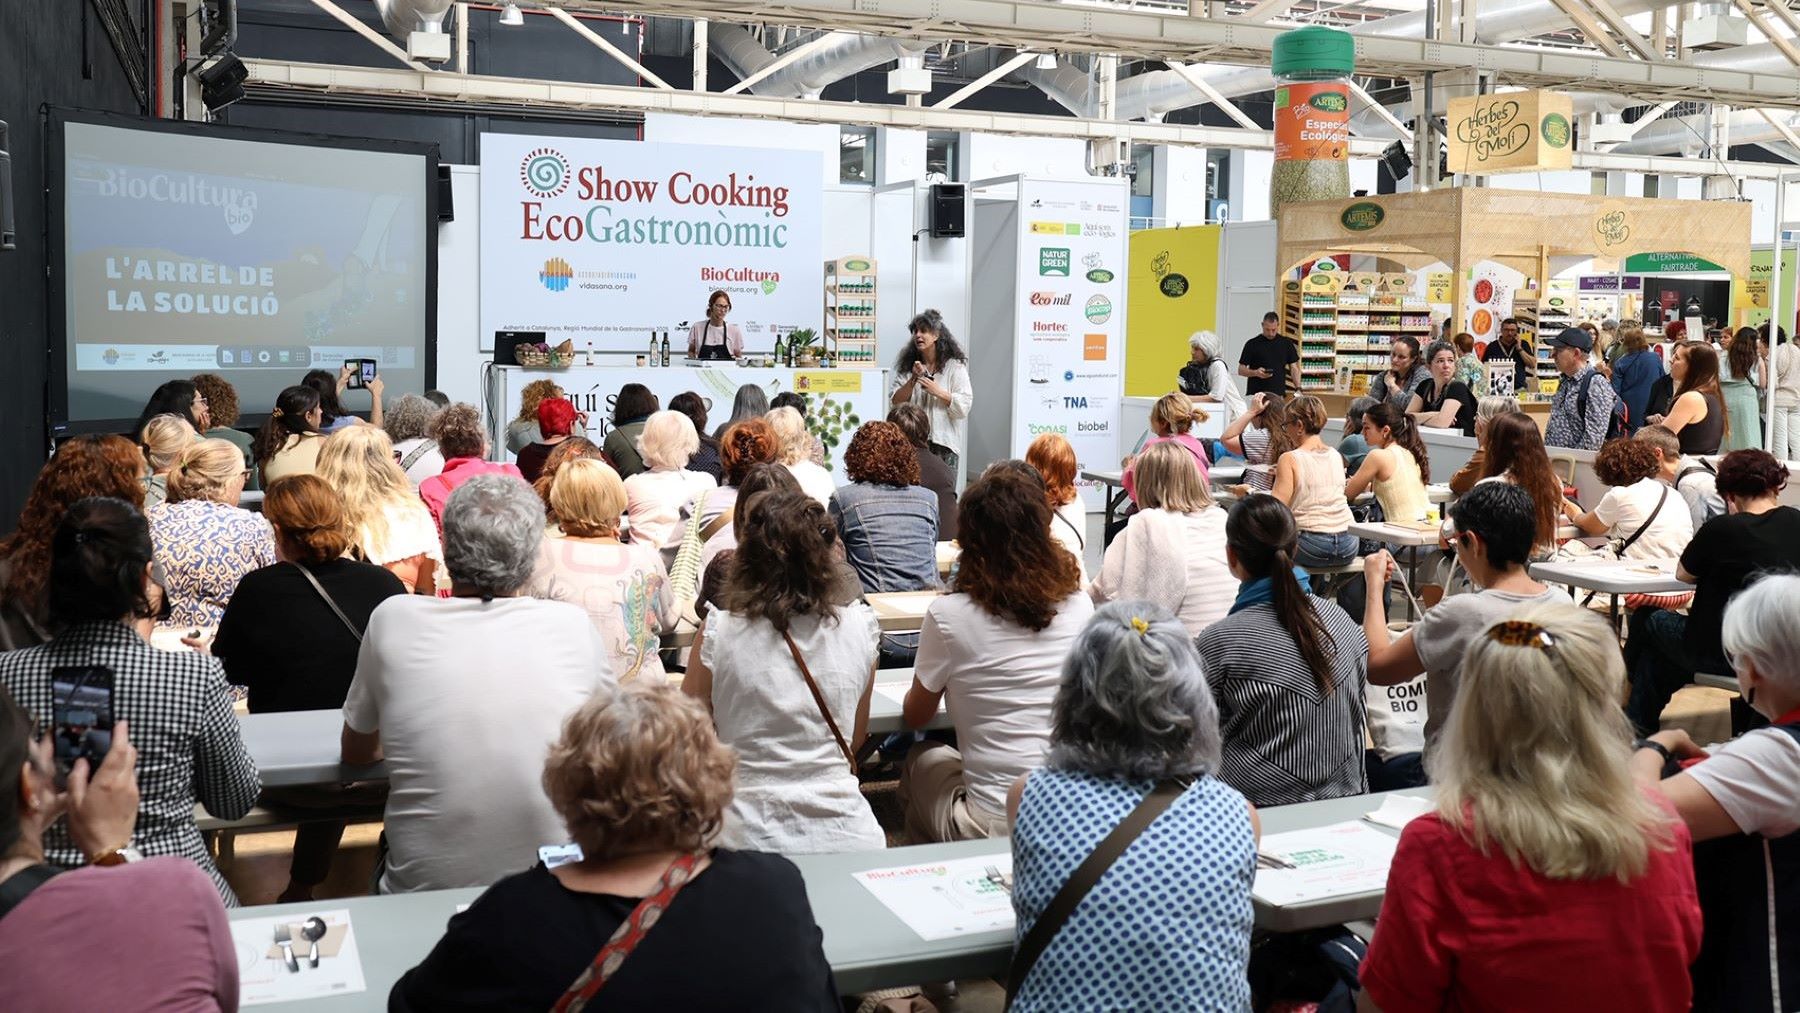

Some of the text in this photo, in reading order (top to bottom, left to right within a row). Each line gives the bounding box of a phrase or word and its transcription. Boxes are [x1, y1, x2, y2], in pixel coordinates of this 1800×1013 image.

[1486, 123, 1500, 138] del
[101, 169, 258, 210] BioCultura
[577, 166, 789, 217] Show Cooking
[228, 208, 250, 225] bio
[1346, 211, 1377, 225] ARTEMIS
[520, 200, 788, 249] EcoGastronòmic
[1042, 250, 1067, 258] NATUR
[1042, 258, 1067, 268] GREEN
[1661, 262, 1699, 271] FAIRTRADE
[106, 256, 274, 287] L'ARREL DE
[701, 267, 780, 283] BioCultura
[579, 282, 628, 292] vidasana.org
[107, 289, 279, 316] LA SOLUCIÓ
[1030, 291, 1073, 306] eco mil
[1033, 321, 1068, 332] Hortec
[1063, 396, 1088, 409] TNA
[1078, 420, 1109, 431] biobel
[1390, 700, 1418, 712] BIO
